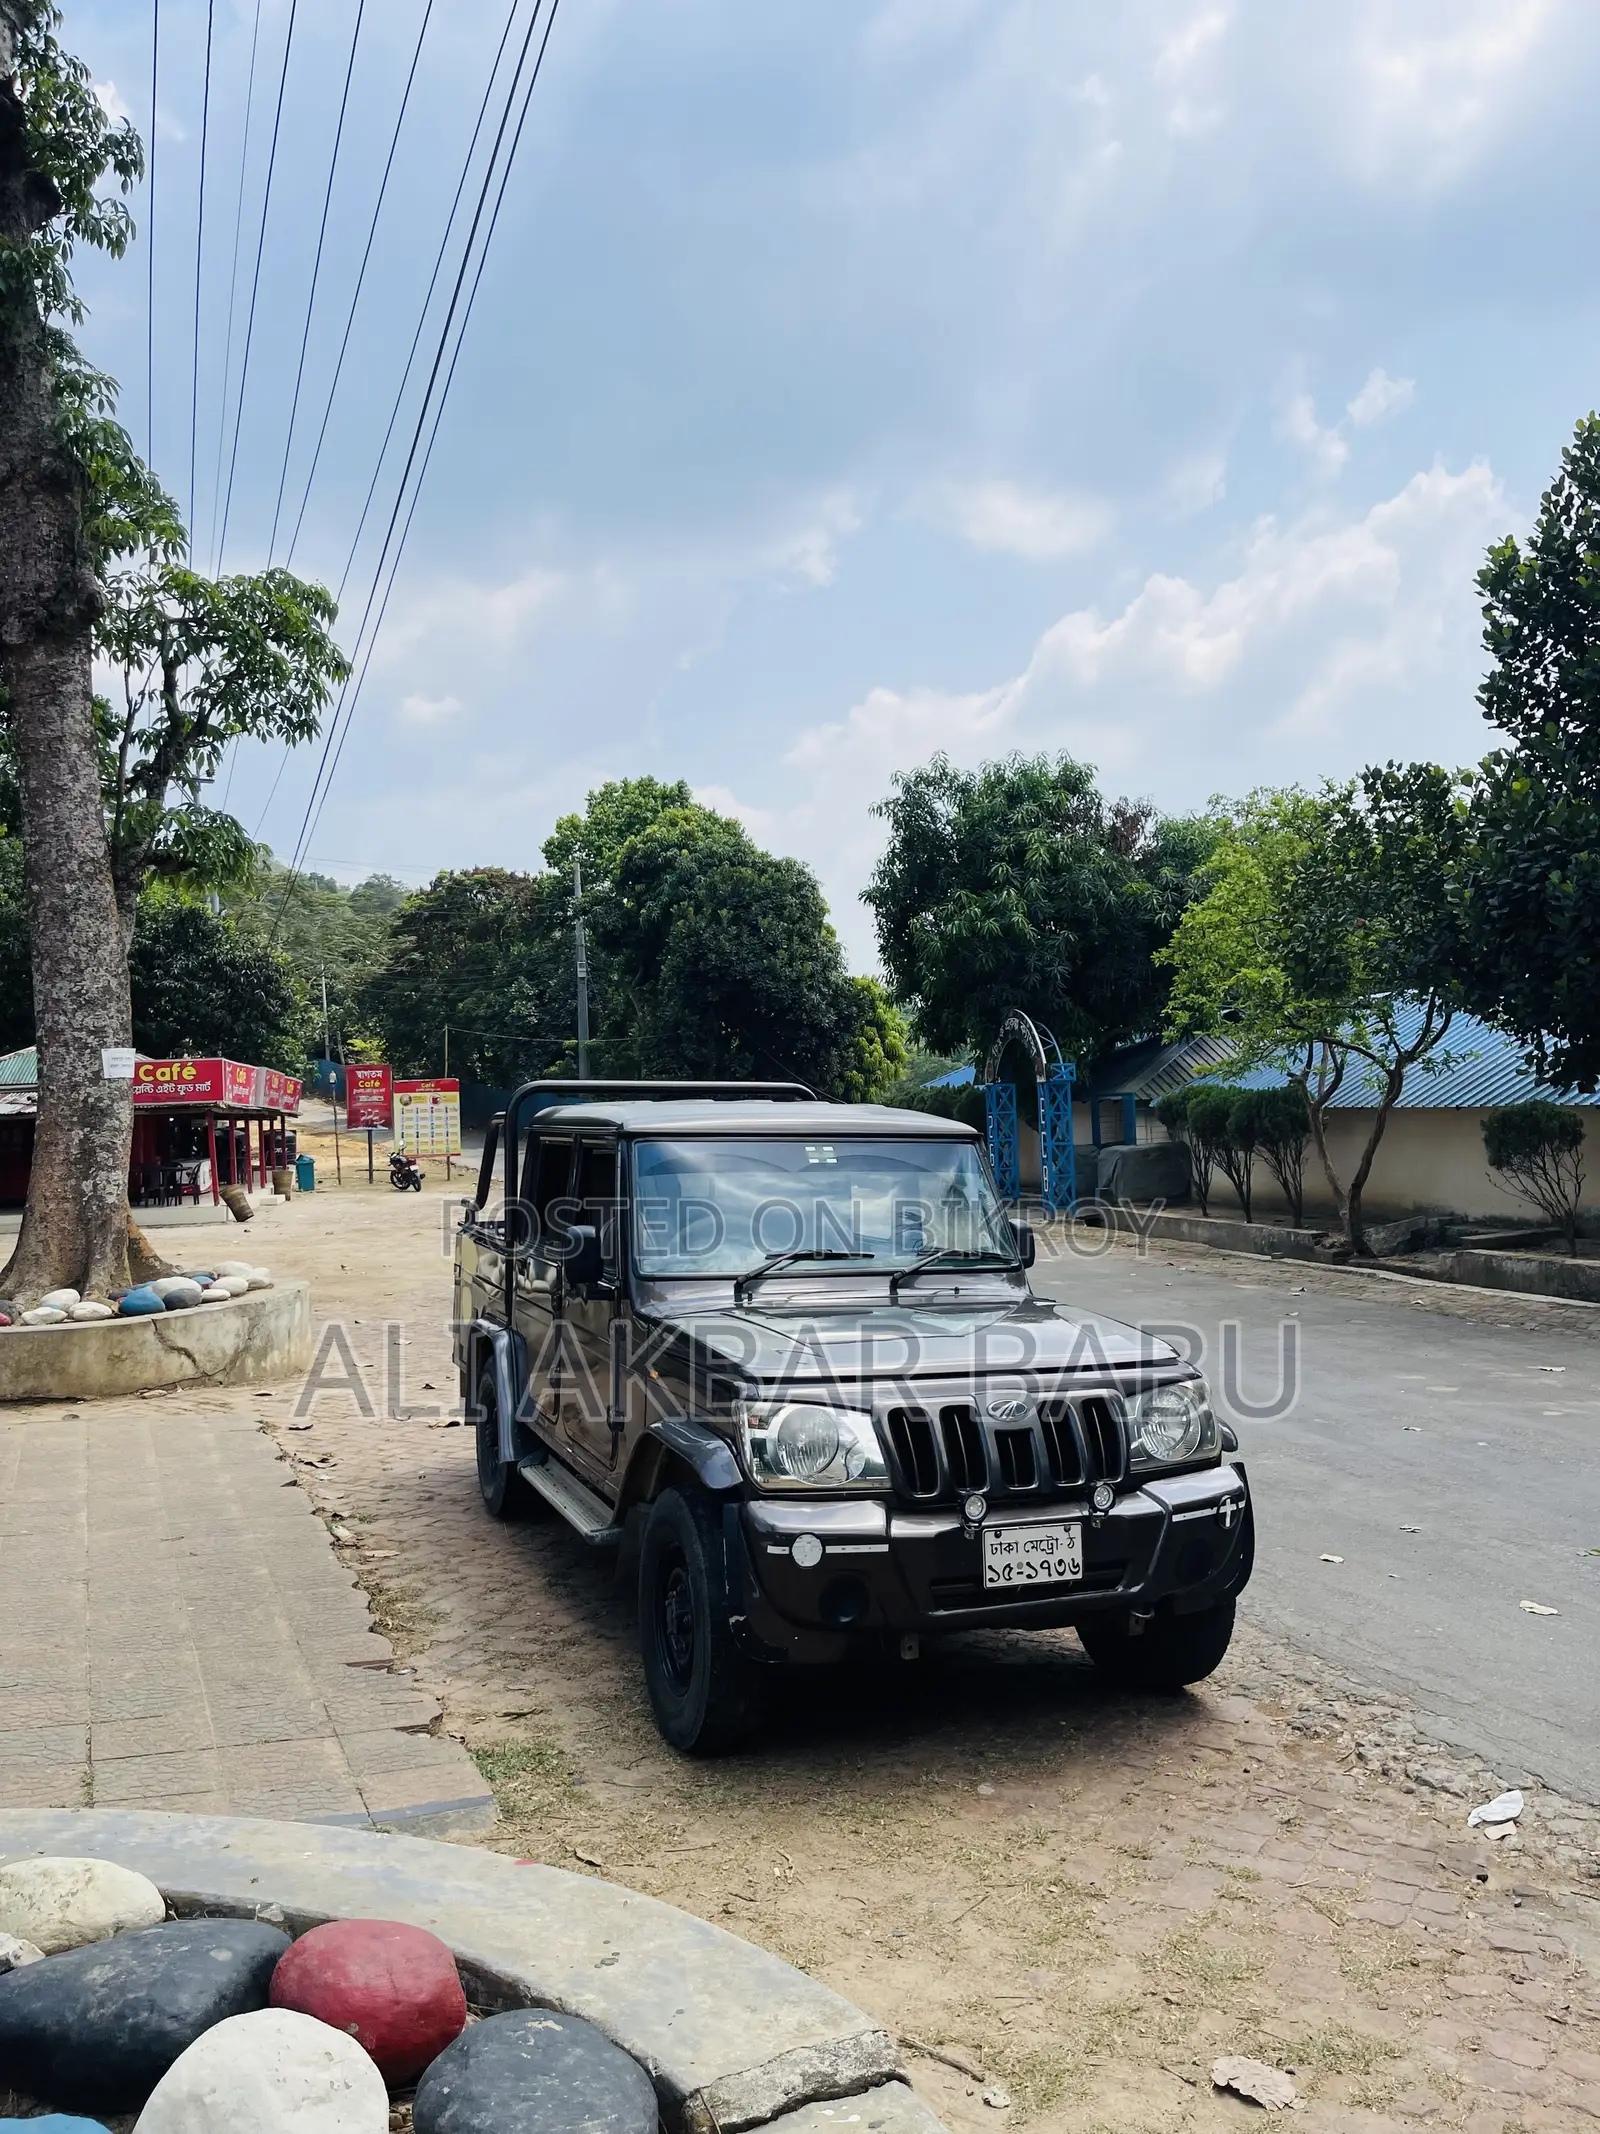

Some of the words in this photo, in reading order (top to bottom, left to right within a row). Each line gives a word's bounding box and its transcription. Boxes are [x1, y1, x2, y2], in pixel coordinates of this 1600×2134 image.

[139, 1063, 197, 1082] Café
[355, 1070, 383, 1079] স্বাগতম
[132, 1083, 154, 1095] য়েন্টি
[156, 1083, 176, 1094] এইট
[177, 1083, 194, 1096] ফুড
[195, 1080, 212, 1092] মার্ট
[358, 1080, 381, 1088] Café
[990, 1541, 1019, 1555] ঢাকা
[987, 1558, 1081, 1583] ১৫-১৭৩৬
